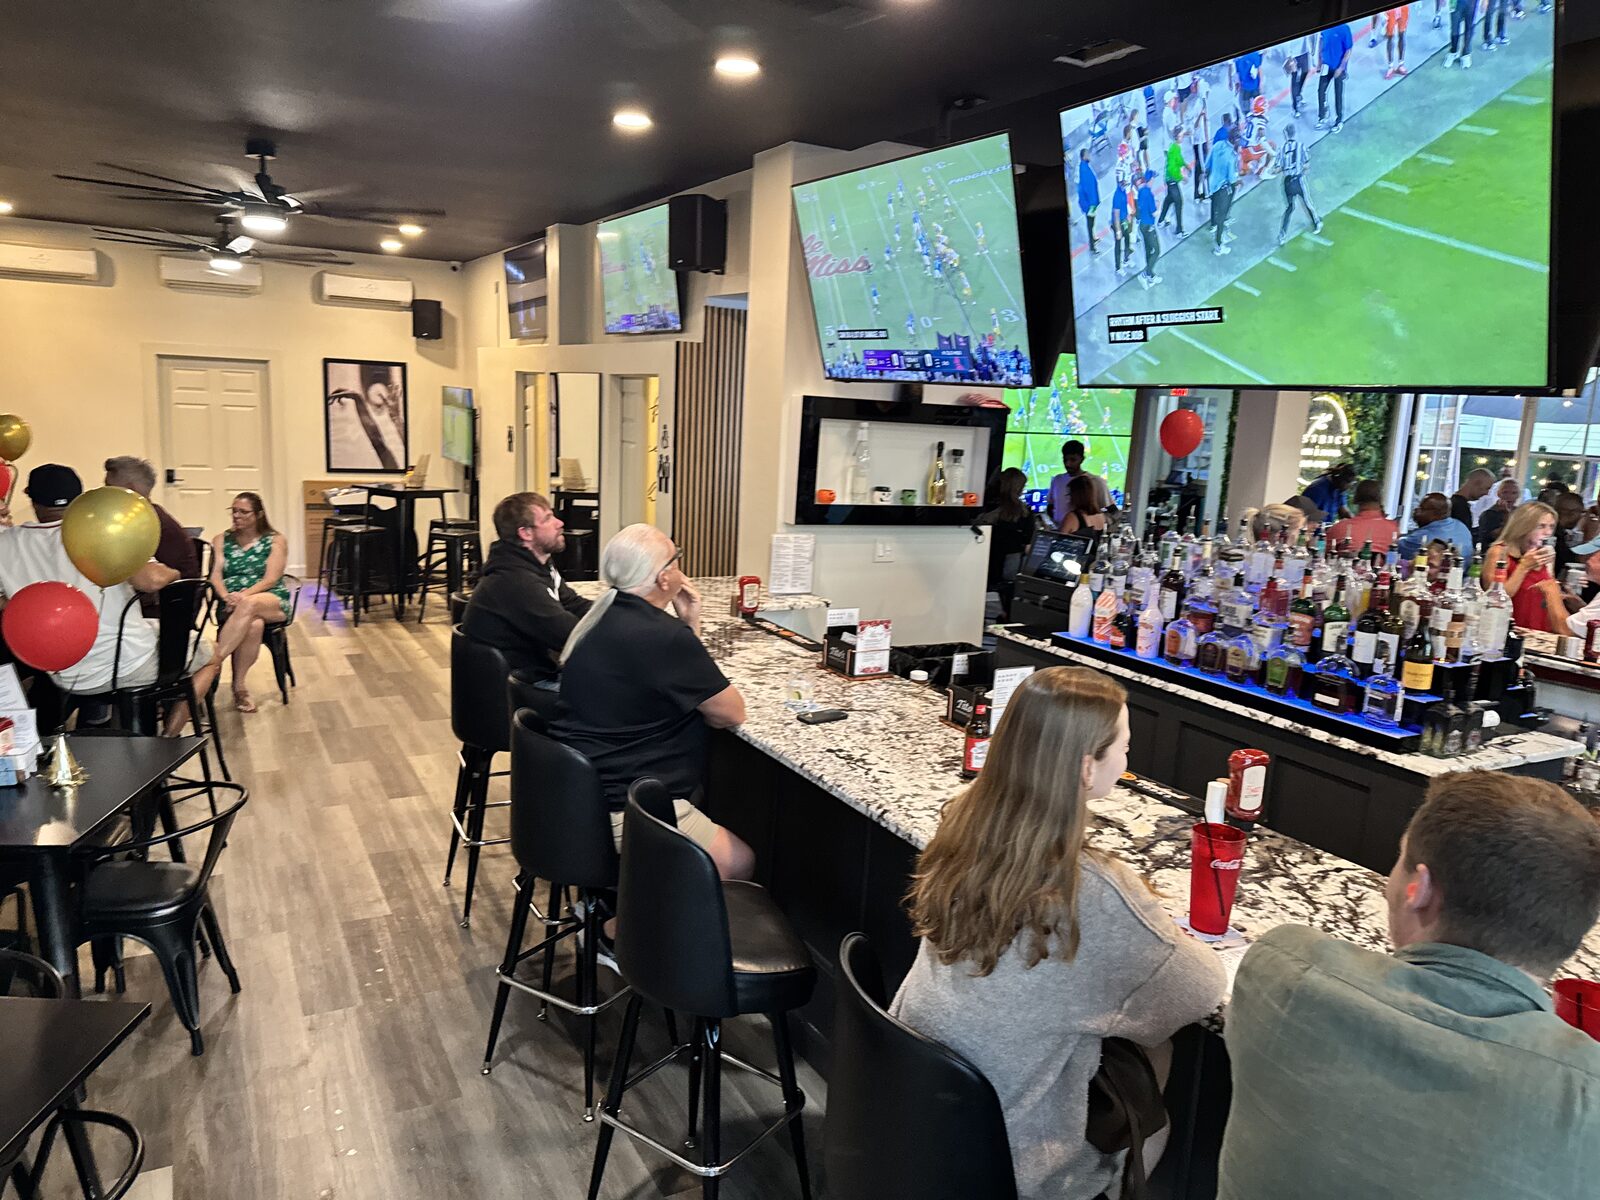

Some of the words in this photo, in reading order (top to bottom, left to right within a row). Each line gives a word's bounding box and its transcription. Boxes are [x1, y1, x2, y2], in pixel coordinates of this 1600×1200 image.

[807, 253, 871, 278] Miss
[1135, 314, 1155, 325] AFTER
[1161, 311, 1195, 323] SLUGGISH
[1301, 433, 1352, 445] STRICT
[956, 699, 974, 713] Tito
